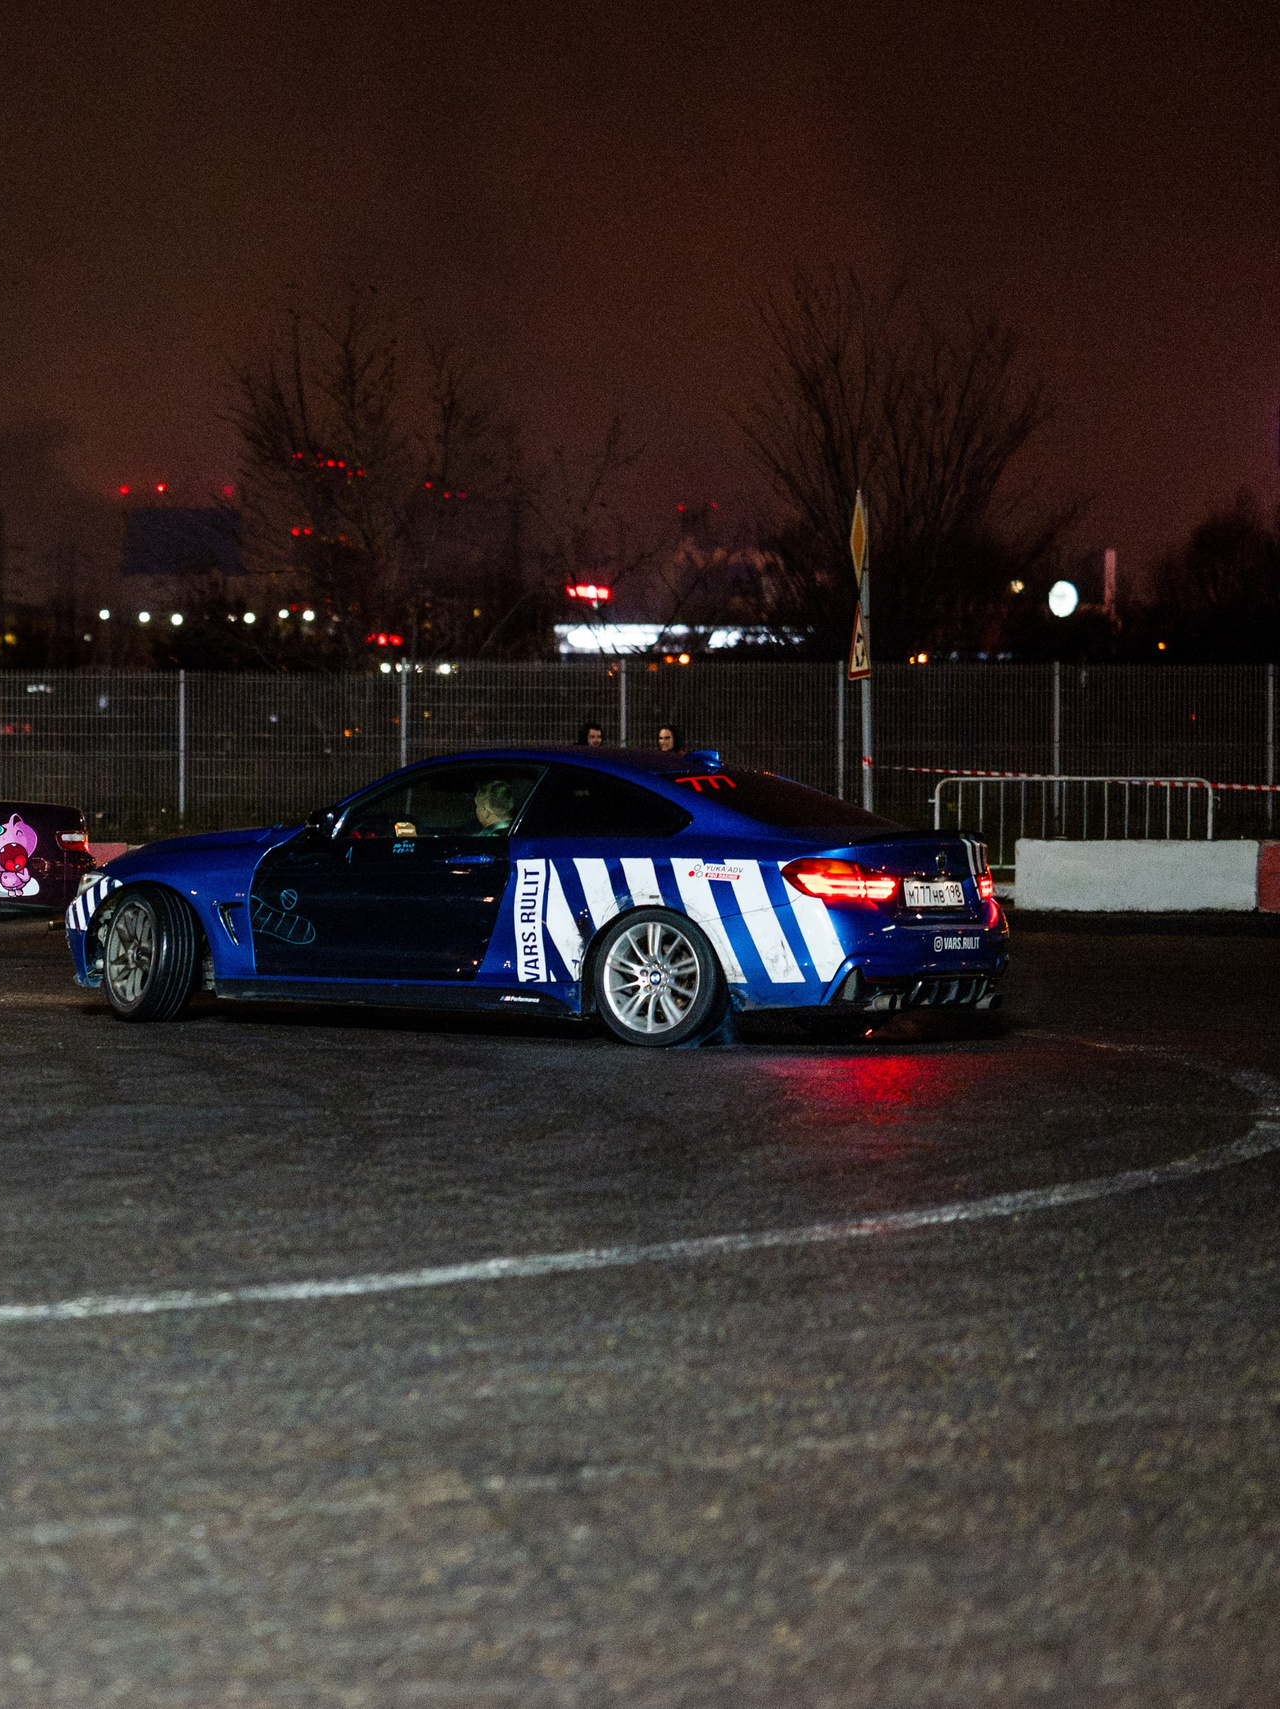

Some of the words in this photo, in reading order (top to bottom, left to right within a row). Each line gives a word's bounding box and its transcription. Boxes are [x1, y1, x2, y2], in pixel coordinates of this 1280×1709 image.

[945, 884, 962, 899] 198
[520, 868, 540, 982] VARS.RULIT
[943, 936, 980, 950] VARS.RULIT
